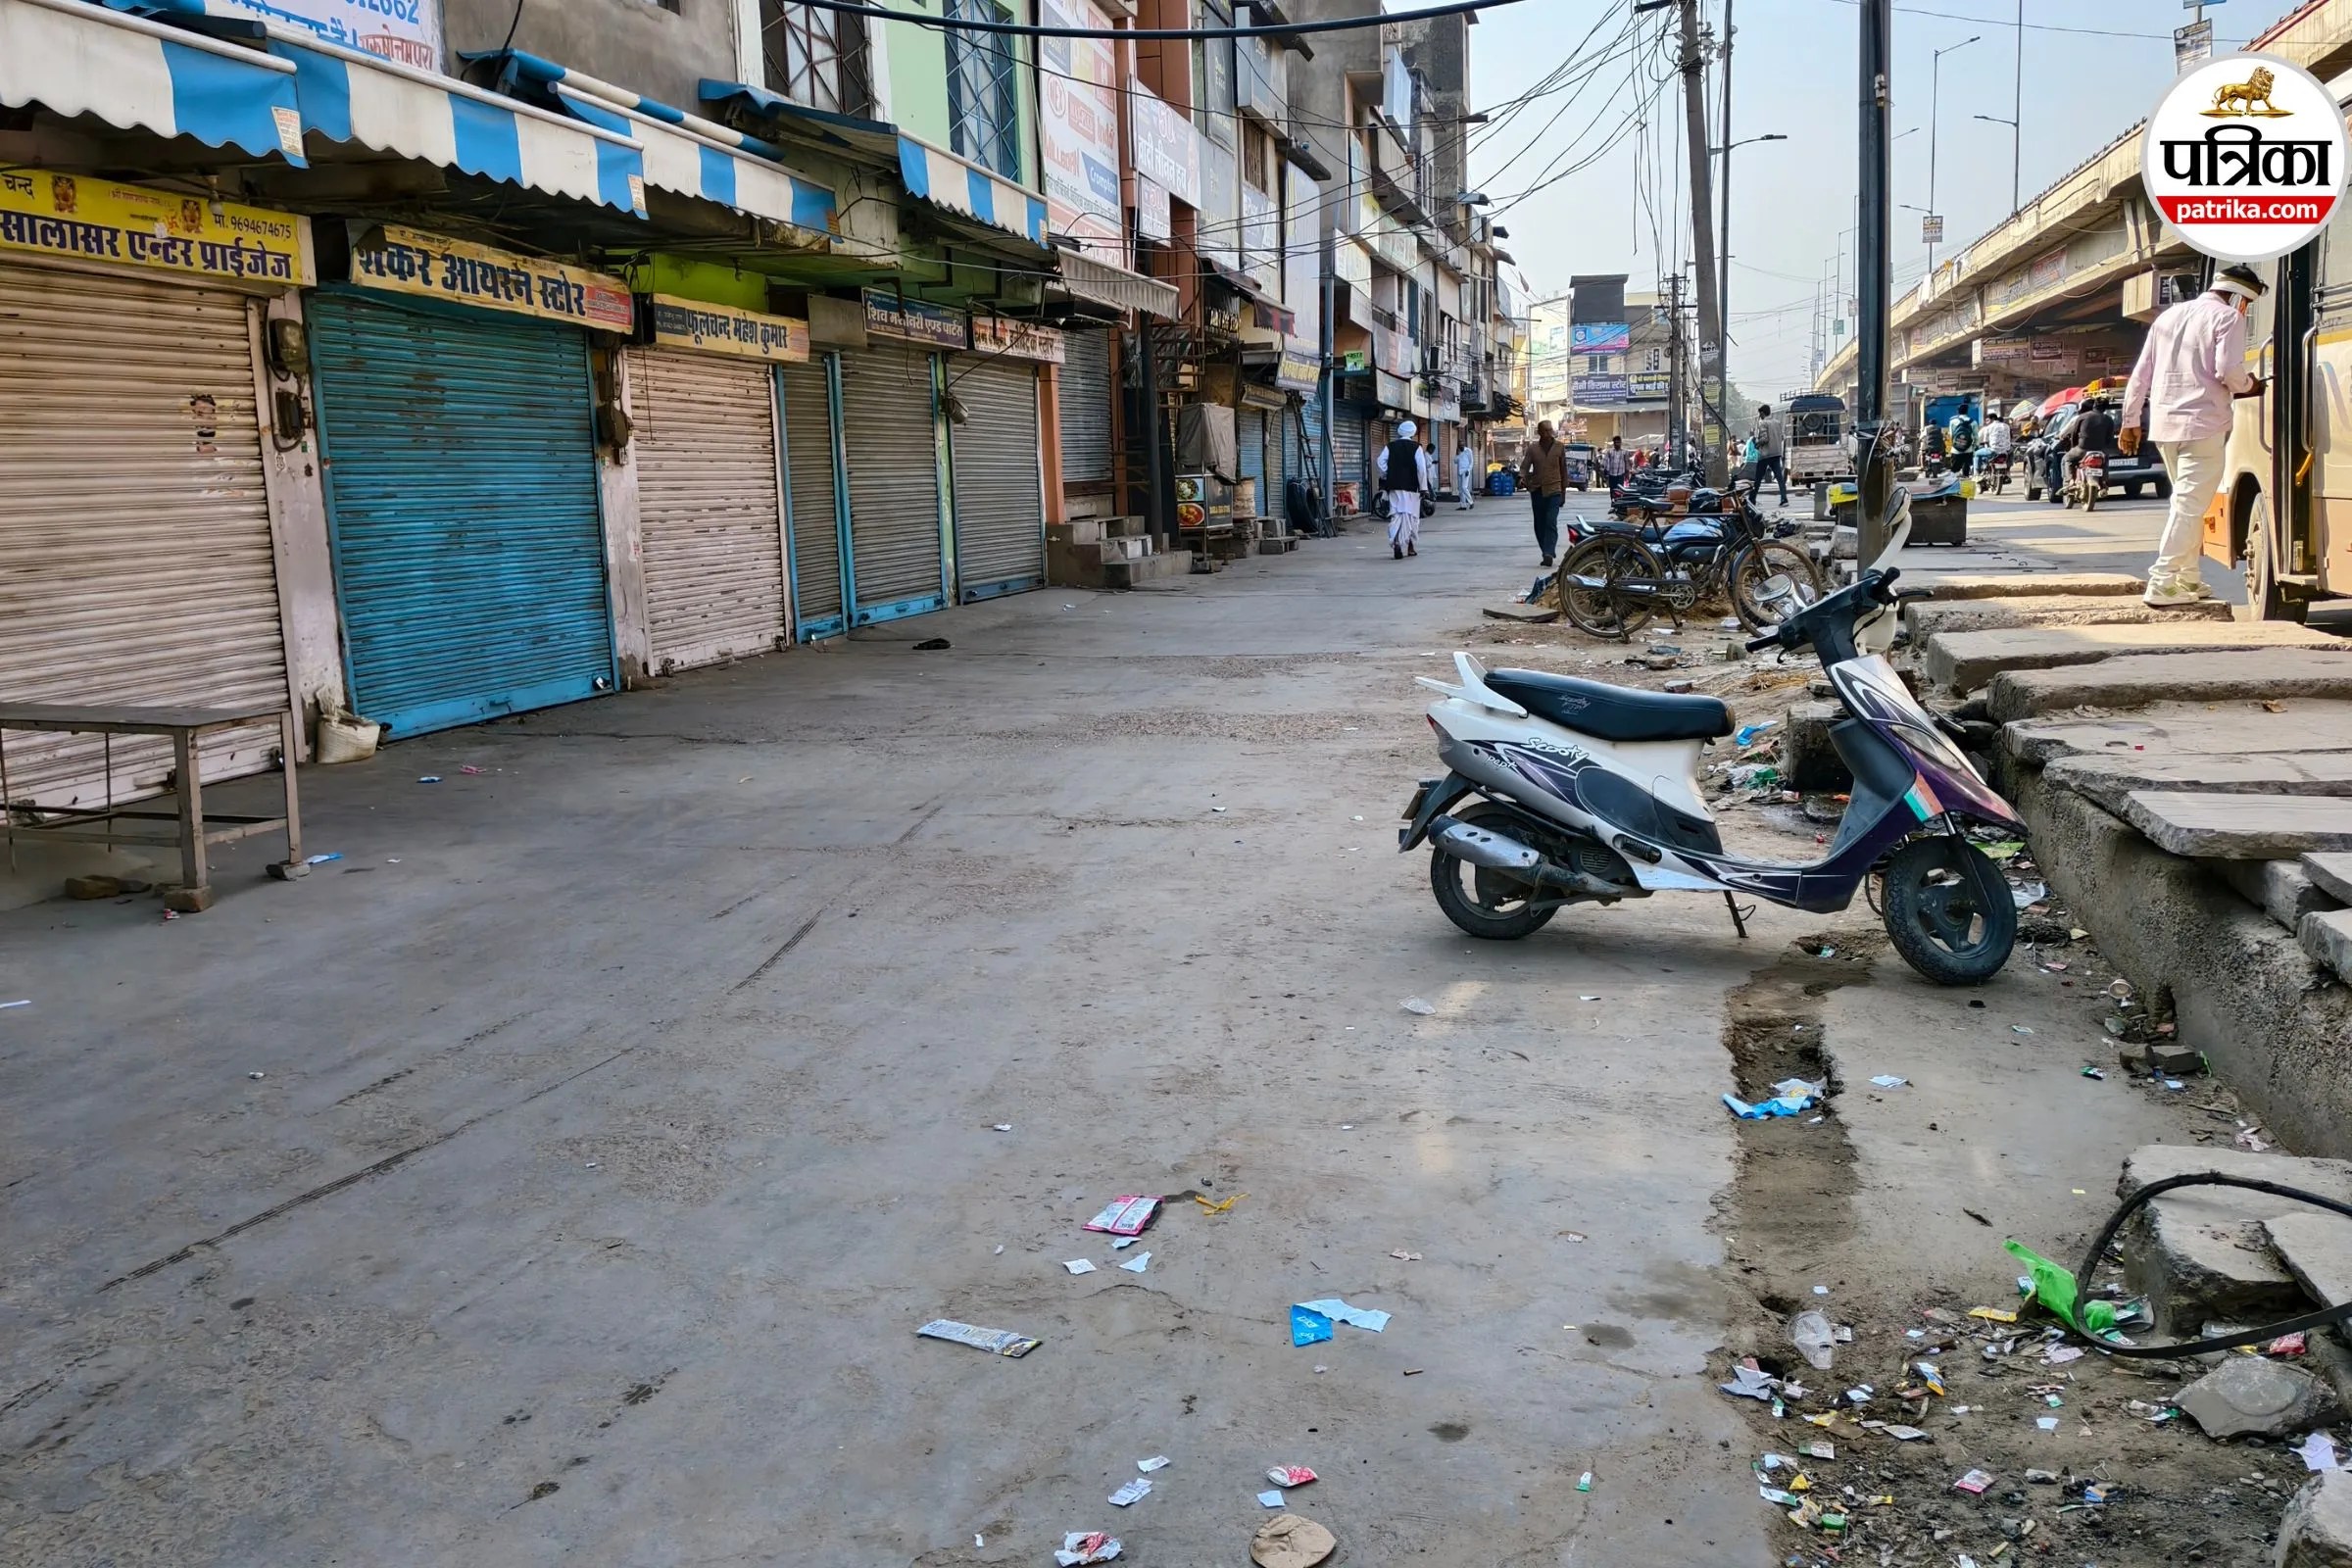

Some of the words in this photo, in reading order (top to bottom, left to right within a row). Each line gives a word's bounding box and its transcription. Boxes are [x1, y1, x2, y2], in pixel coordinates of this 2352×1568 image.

[1089, 166, 1117, 194] Crompton
[0, 209, 121, 258] सालासर
[124, 229, 195, 268] एन्टर
[198, 236, 292, 280] प्राईजेज
[230, 217, 292, 239] 9694674675
[441, 252, 535, 306] आयरन
[537, 270, 586, 318] स्टोर
[686, 309, 731, 346] फूलचन्द
[732, 312, 759, 345] महेश
[760, 321, 789, 355] कुमार
[866, 300, 888, 323] शिव
[889, 309, 924, 330] मशीनरी
[924, 318, 942, 334] एण्ड
[1520, 737, 1591, 767] Scooty
